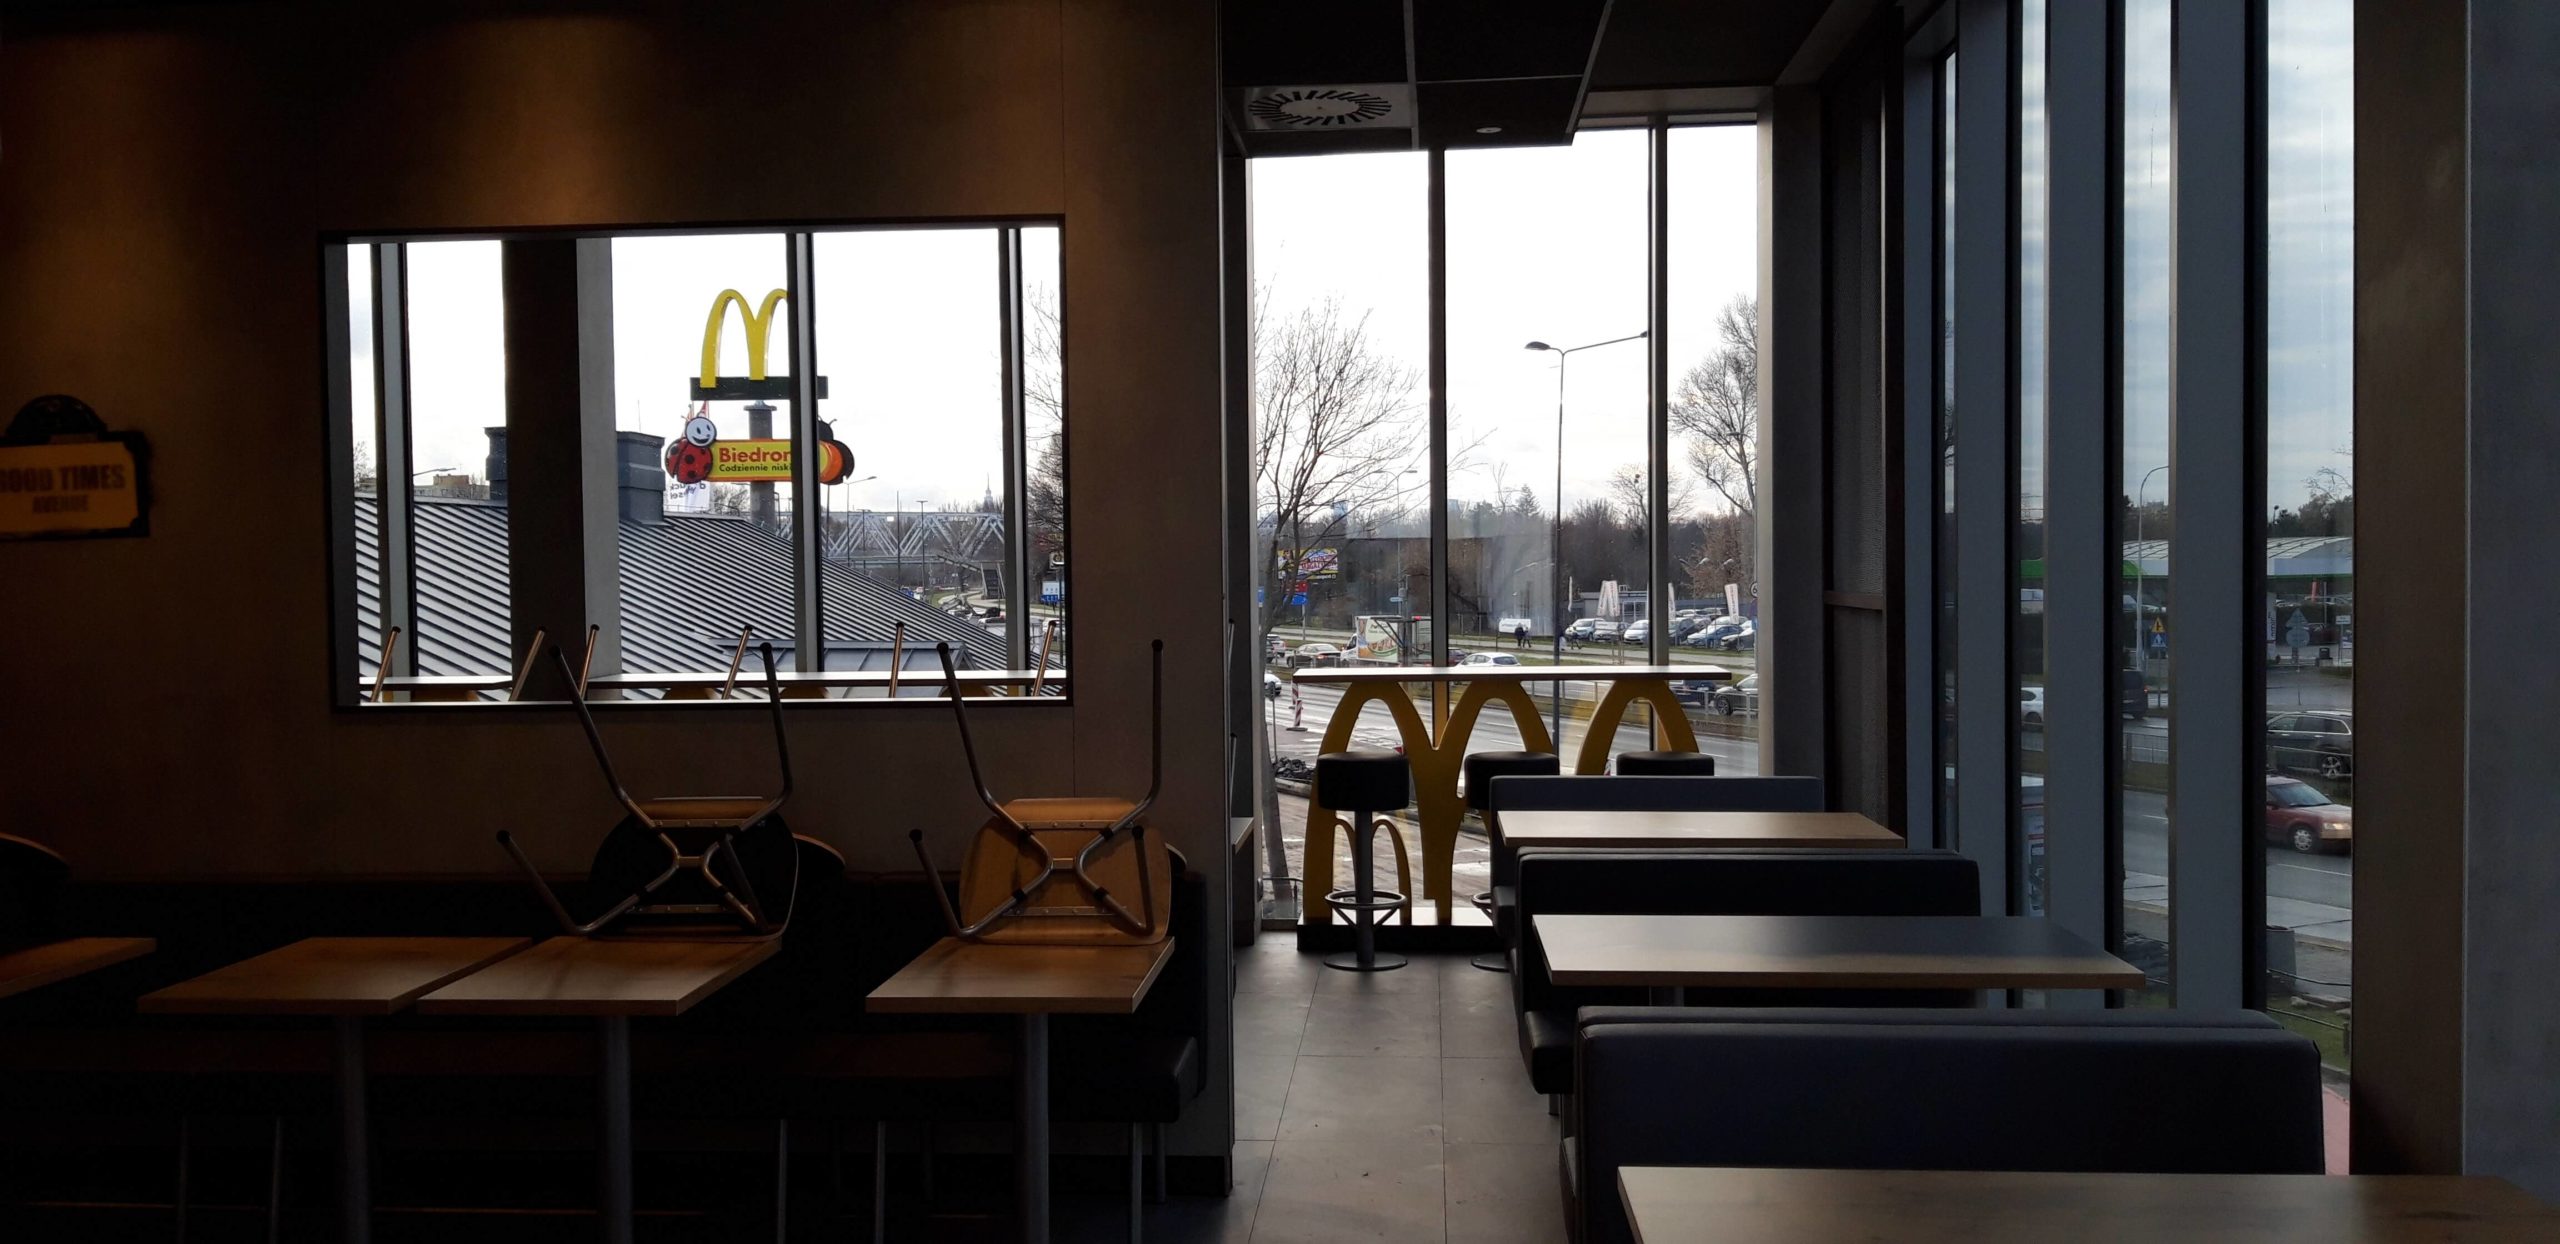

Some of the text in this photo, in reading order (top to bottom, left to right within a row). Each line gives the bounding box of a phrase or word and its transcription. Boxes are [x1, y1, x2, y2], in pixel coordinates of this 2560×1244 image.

[719, 447, 791, 463] Biedron
[718, 464, 769, 472] Codziennie
[59, 464, 126, 490] TIMES
